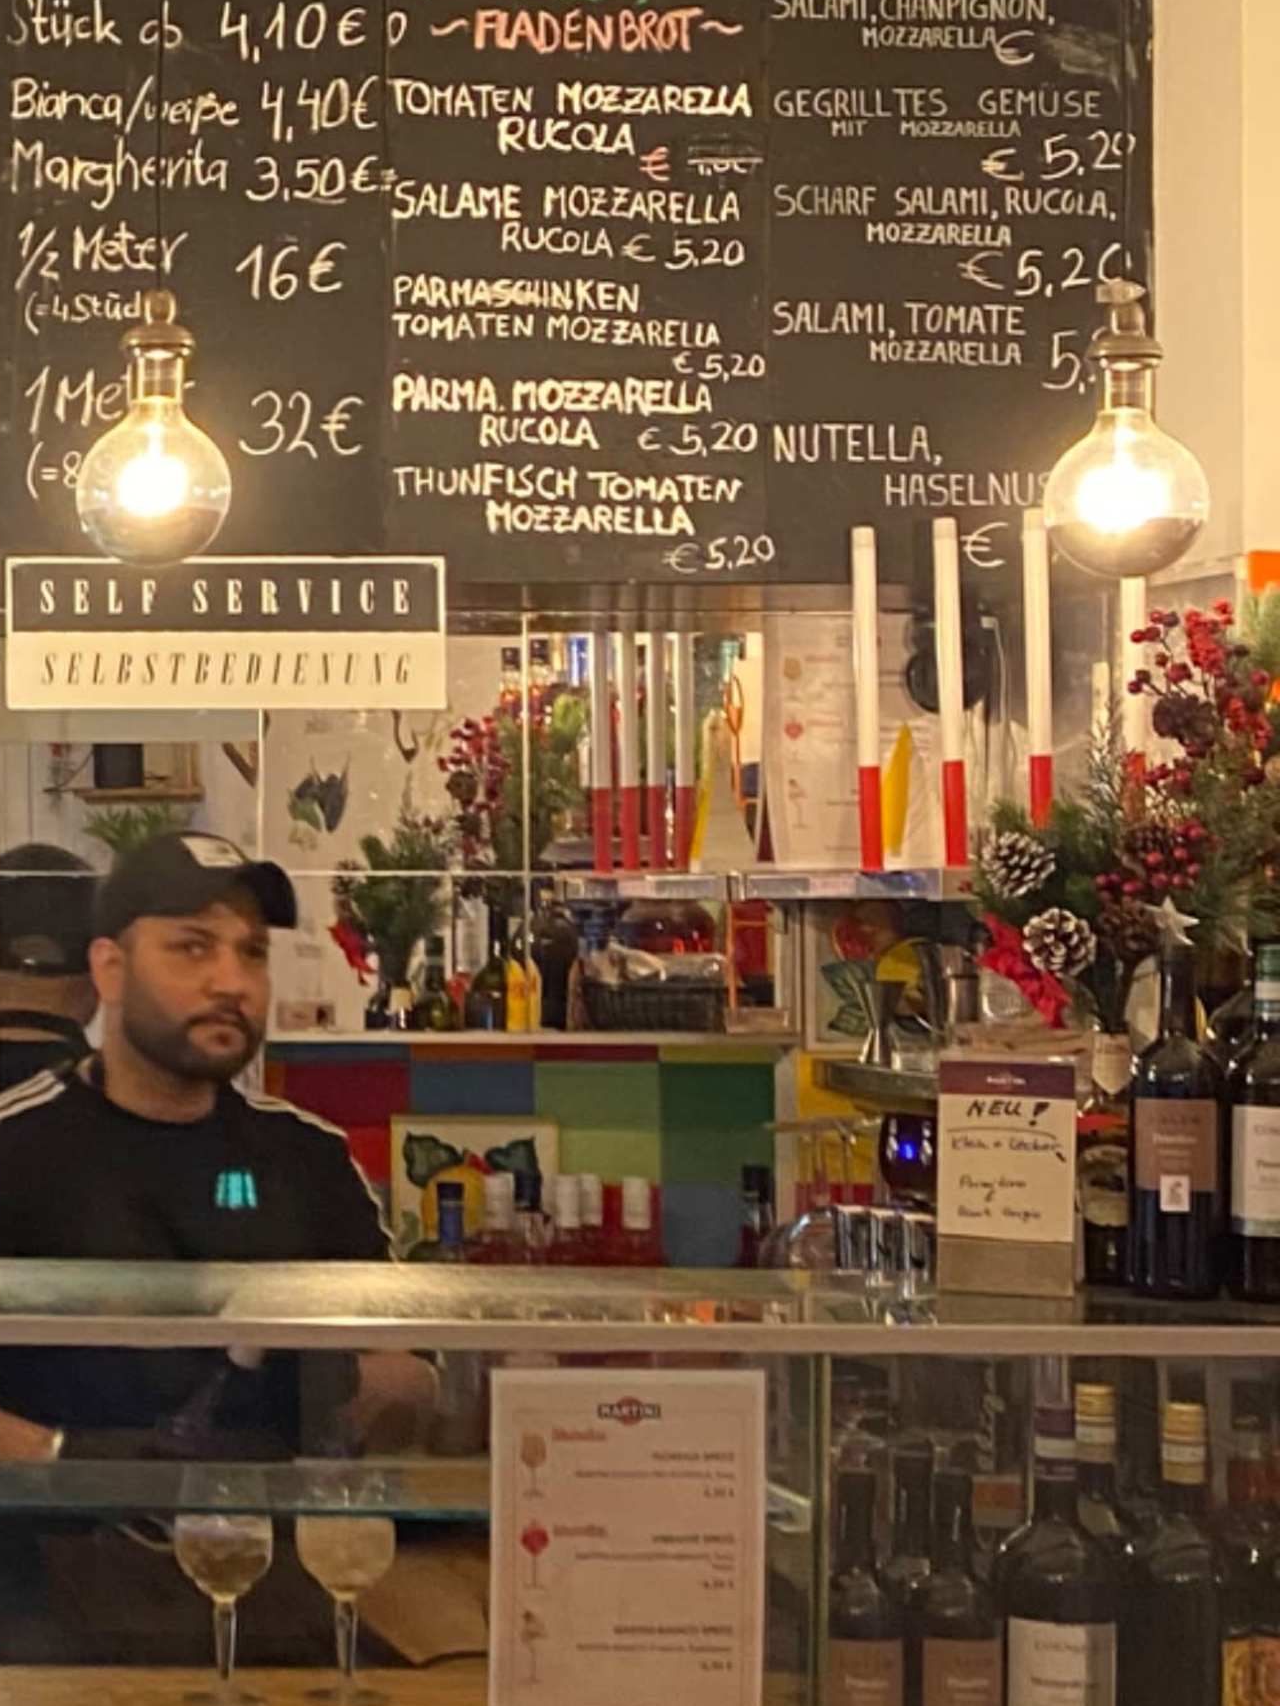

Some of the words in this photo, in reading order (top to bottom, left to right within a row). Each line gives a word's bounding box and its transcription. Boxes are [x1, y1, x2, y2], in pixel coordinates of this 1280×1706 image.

[474, 7, 704, 55] FLADENBROT
[863, 26, 997, 49] MOZZARELLA
[386, 78, 534, 118] TOMATEN
[557, 81, 753, 118] MOZZARELLA
[773, 87, 948, 118] GEGRILLTES
[497, 115, 636, 156] RUCOLA
[831, 121, 866, 137] MIT
[899, 119, 1022, 139] MOZZARELLA
[10, 136, 228, 211] Margherita
[390, 180, 522, 220] SALAME
[543, 184, 740, 225] MOZZARELLA
[773, 184, 877, 217] SCHARF
[72, 221, 188, 274] Meter
[501, 220, 614, 259] RUCOLA
[866, 222, 1012, 248] MOZZARELLA
[391, 311, 535, 342] TOMATEN
[546, 314, 721, 348] MOZZARELLA
[904, 302, 1026, 336] TOMATE
[869, 339, 1022, 366] MOZZARELLA
[511, 376, 713, 417] MOZZARELLA
[479, 413, 600, 450] RUCOLA
[392, 462, 579, 501] THUNFISCH
[586, 471, 743, 503] TOMATEN
[485, 499, 695, 537] MOZZARELLA
[39, 578, 157, 615] SELF
[192, 578, 410, 615] SERVICE
[41, 652, 411, 687] SELBSTBEDIENUNG
